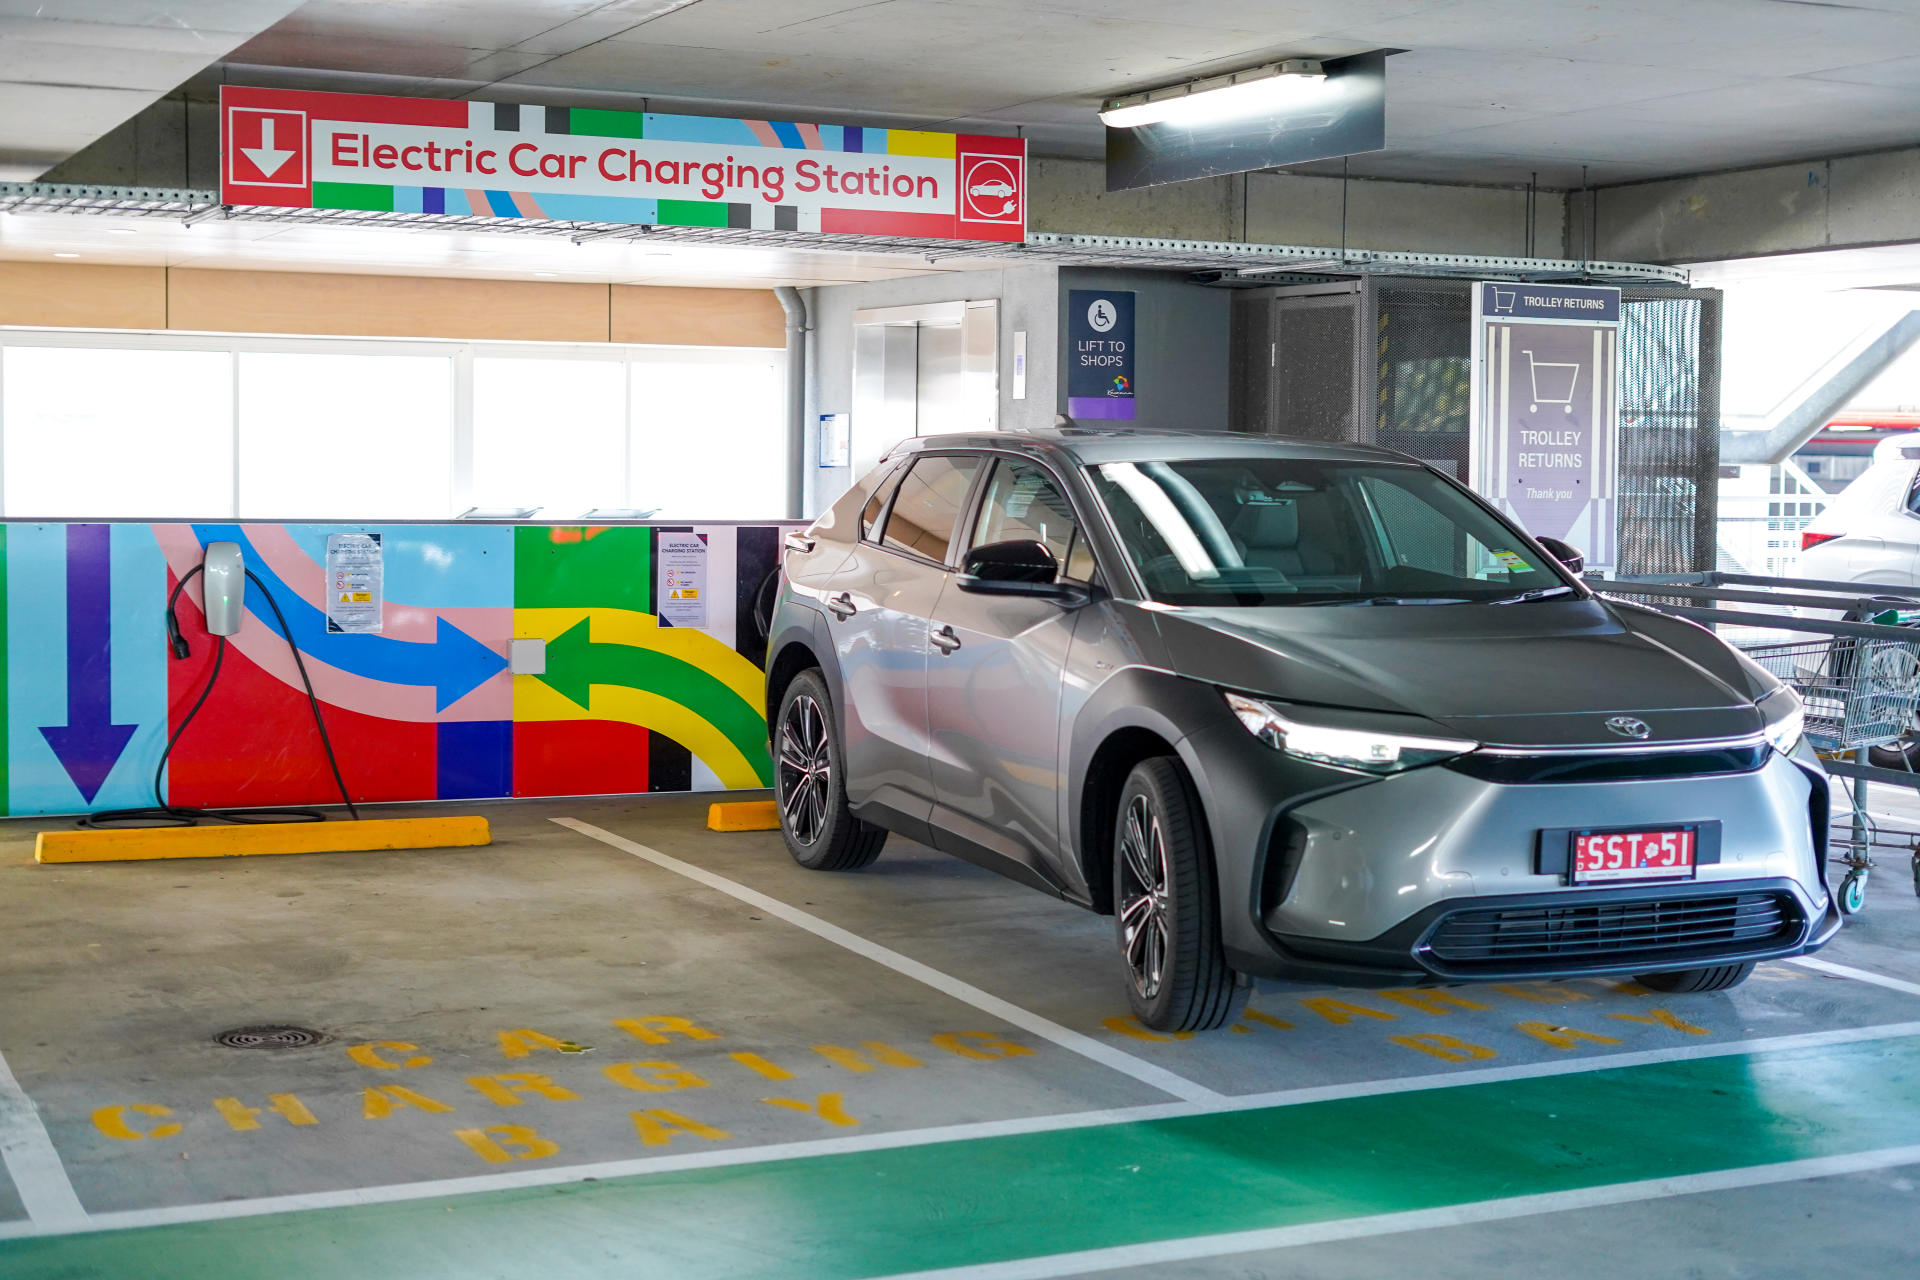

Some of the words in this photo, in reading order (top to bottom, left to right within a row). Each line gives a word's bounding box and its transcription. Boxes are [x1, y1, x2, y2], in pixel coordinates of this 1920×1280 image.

[331, 131, 497, 175] Electric
[508, 142, 587, 179] Car
[597, 148, 785, 203] Charging
[794, 159, 938, 199] Station
[1523, 296, 1563, 309] TROLLEY
[1564, 298, 1605, 310] RETURNS
[1078, 340, 1104, 352] LIFT
[1108, 341, 1126, 353] TO
[1080, 354, 1123, 367] SHOPS
[1520, 430, 1582, 446] TROLLEY
[1518, 453, 1583, 468] RETURNS
[1526, 487, 1554, 499] Thank
[1555, 490, 1573, 502] you
[1587, 834, 1643, 870] SST
[346, 1016, 723, 1069] CAR
[1389, 1009, 1712, 1062] BAY
[90, 1030, 1037, 1140] CHARGING
[453, 1092, 861, 1163] BAY
